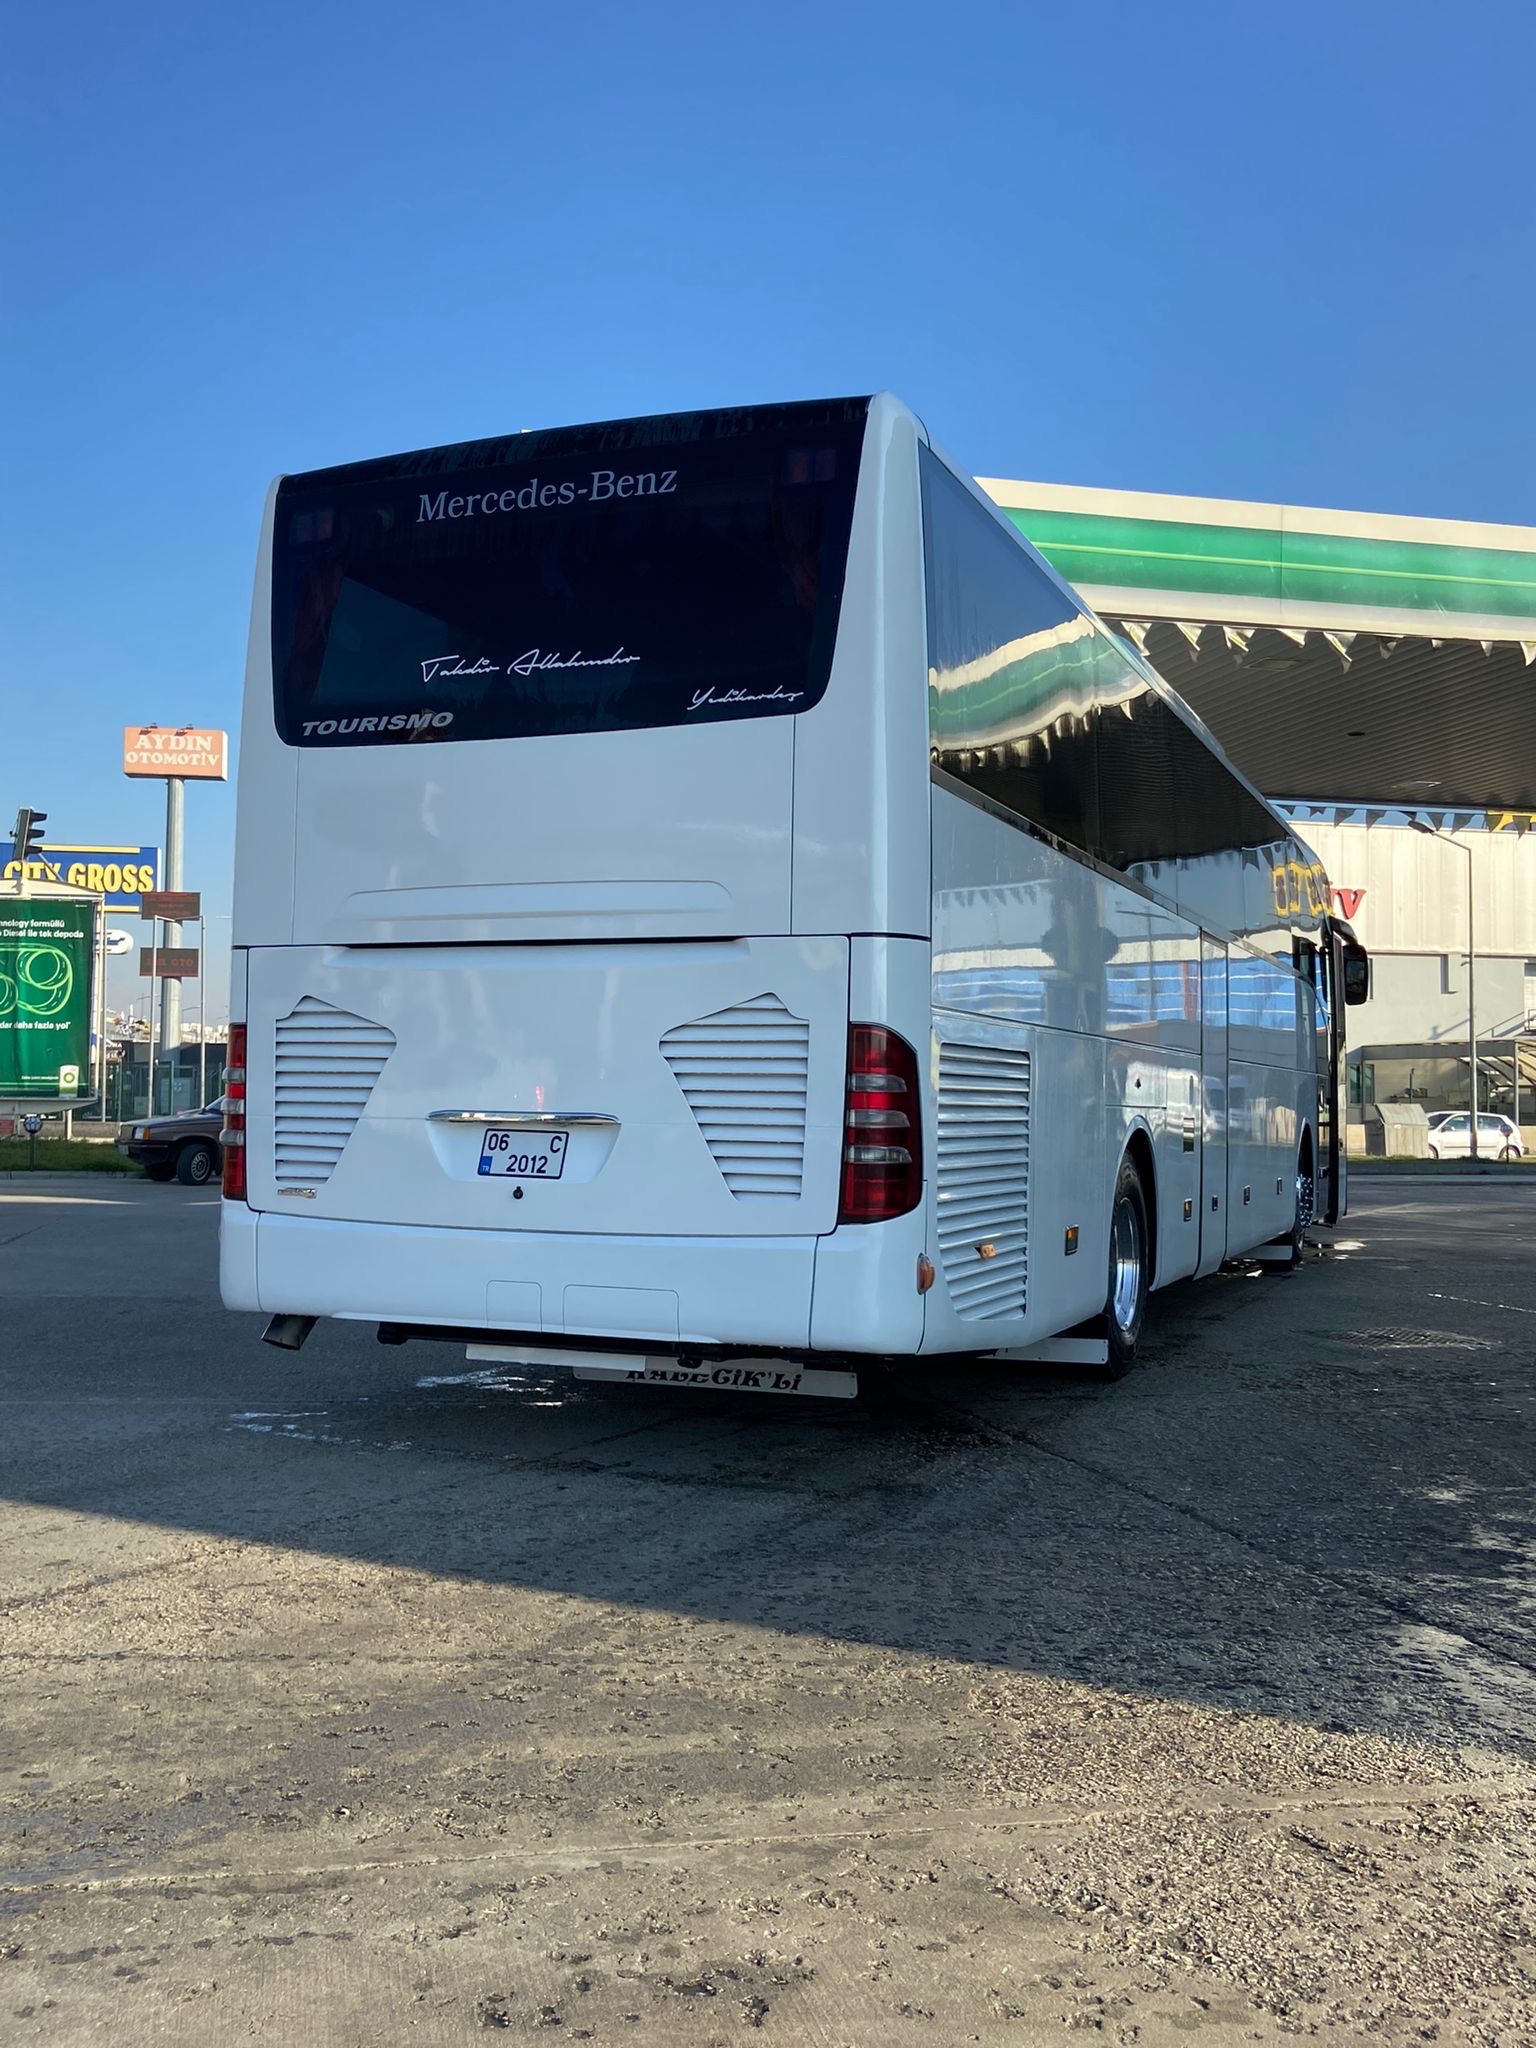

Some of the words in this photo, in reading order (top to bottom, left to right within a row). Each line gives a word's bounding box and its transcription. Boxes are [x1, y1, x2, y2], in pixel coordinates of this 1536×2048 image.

[416, 470, 678, 522] Mercedes-Benz
[302, 712, 454, 736] TOURISMO
[134, 734, 213, 751] AYDIN
[126, 751, 220, 766] OTOMOTİV
[68, 863, 154, 893] GROSS
[54, 930, 84, 939] depoda
[488, 1133, 510, 1151] 06
[550, 1136, 562, 1153] C
[506, 1154, 548, 1173] 2012
